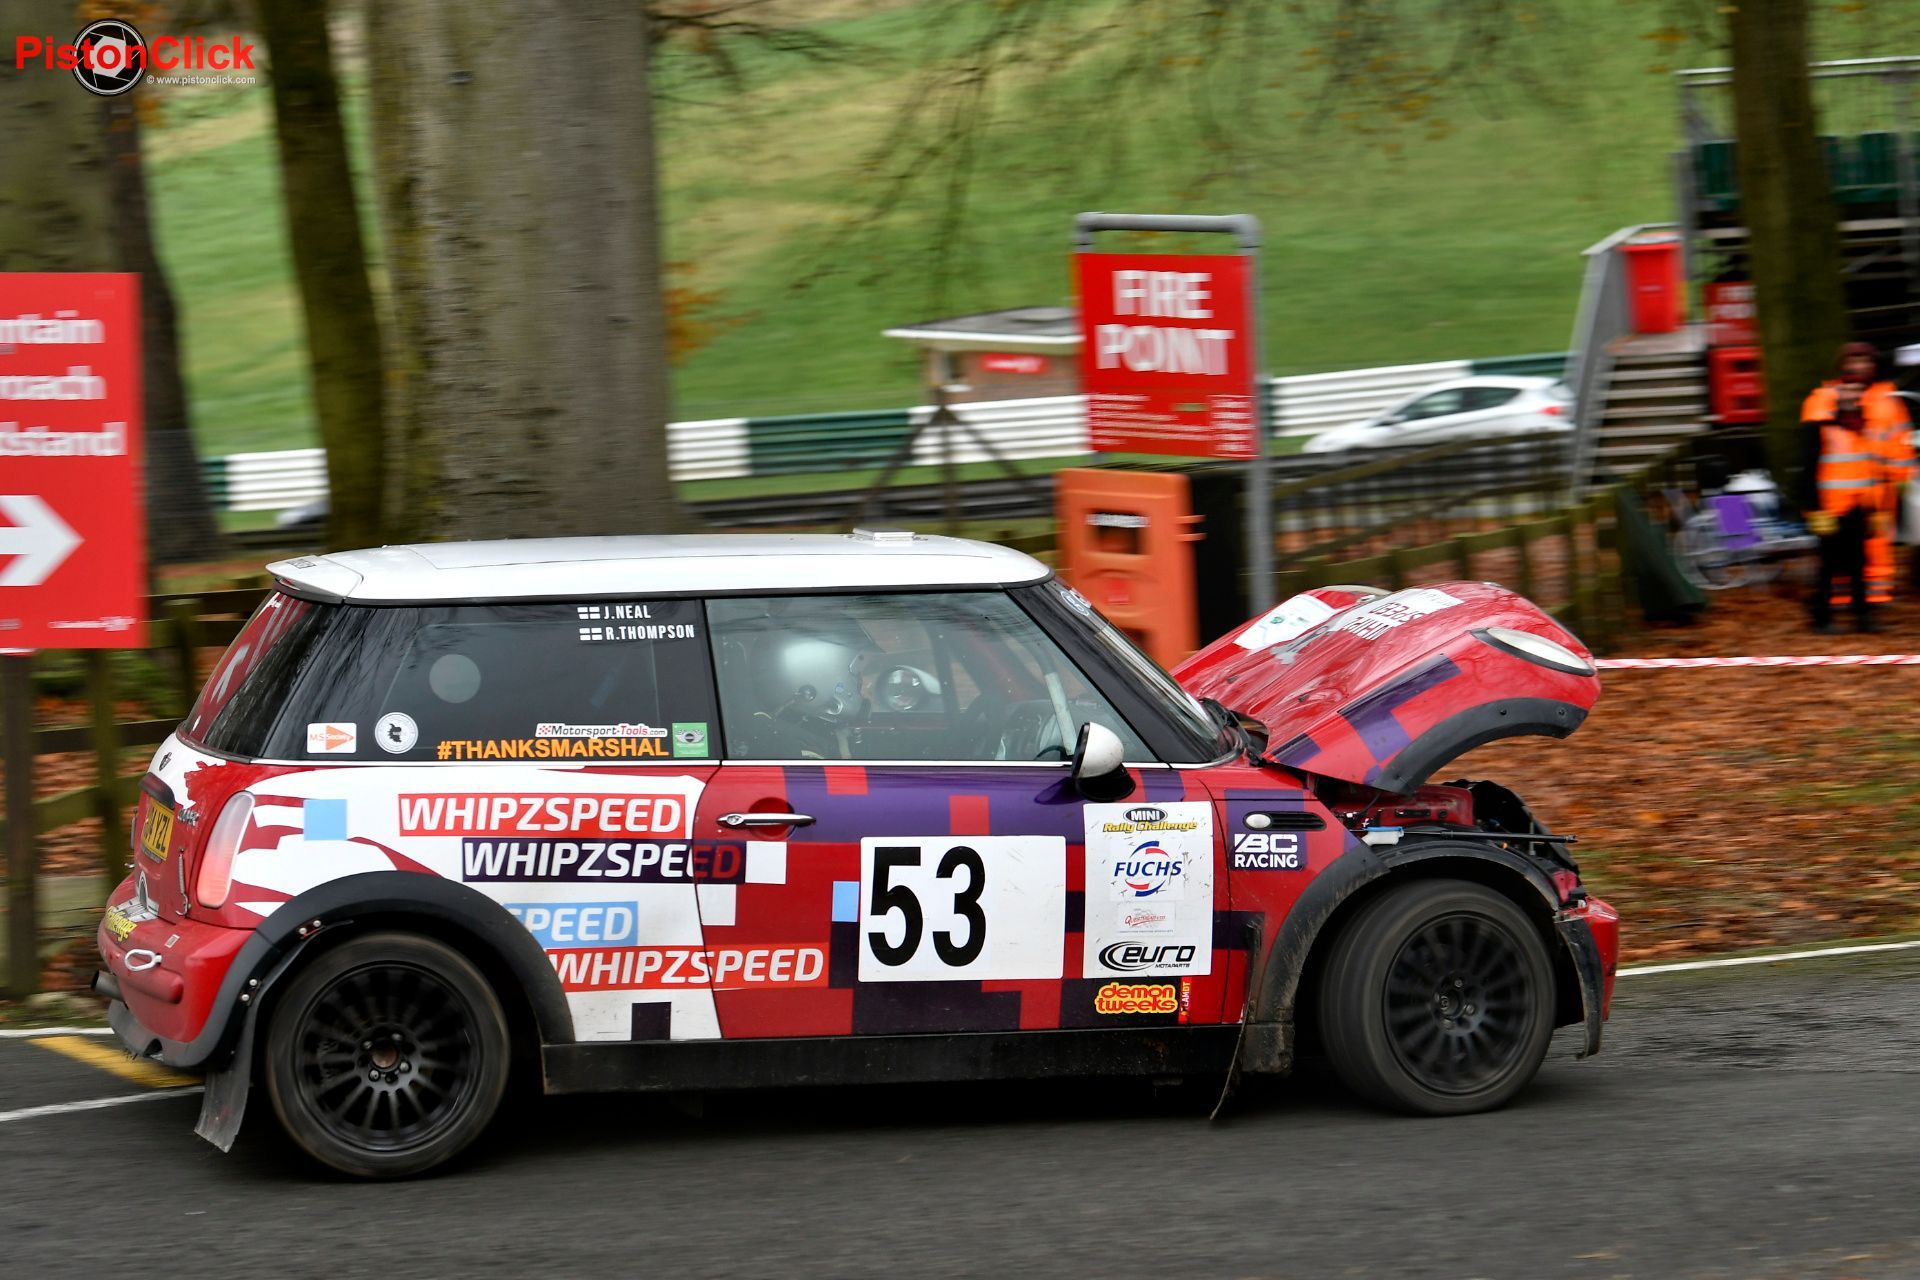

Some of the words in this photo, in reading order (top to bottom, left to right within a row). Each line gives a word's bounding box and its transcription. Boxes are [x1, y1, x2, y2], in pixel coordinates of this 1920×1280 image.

[1112, 270, 1213, 318] FIRE
[1095, 324, 1236, 376] POINT
[604, 605, 651, 619] J.NEAL
[605, 625, 695, 640] R.THOMPSON
[437, 738, 670, 760] #THANKSMARSHAL
[400, 797, 683, 833] WHIPZSPEED
[1130, 810, 1161, 821] MINI
[1103, 822, 1135, 833] Rally
[1136, 821, 1197, 832] Challenge
[464, 842, 743, 878] WHIPZSPEED
[1114, 860, 1183, 877] FUCHS
[1234, 854, 1299, 868] RACING
[867, 845, 987, 968] 53
[506, 906, 633, 942] PEED
[1121, 945, 1196, 963] euro
[547, 947, 824, 985] WHIPZSPEED
[1100, 983, 1175, 999] demon
[1096, 996, 1176, 1012] tweeks
